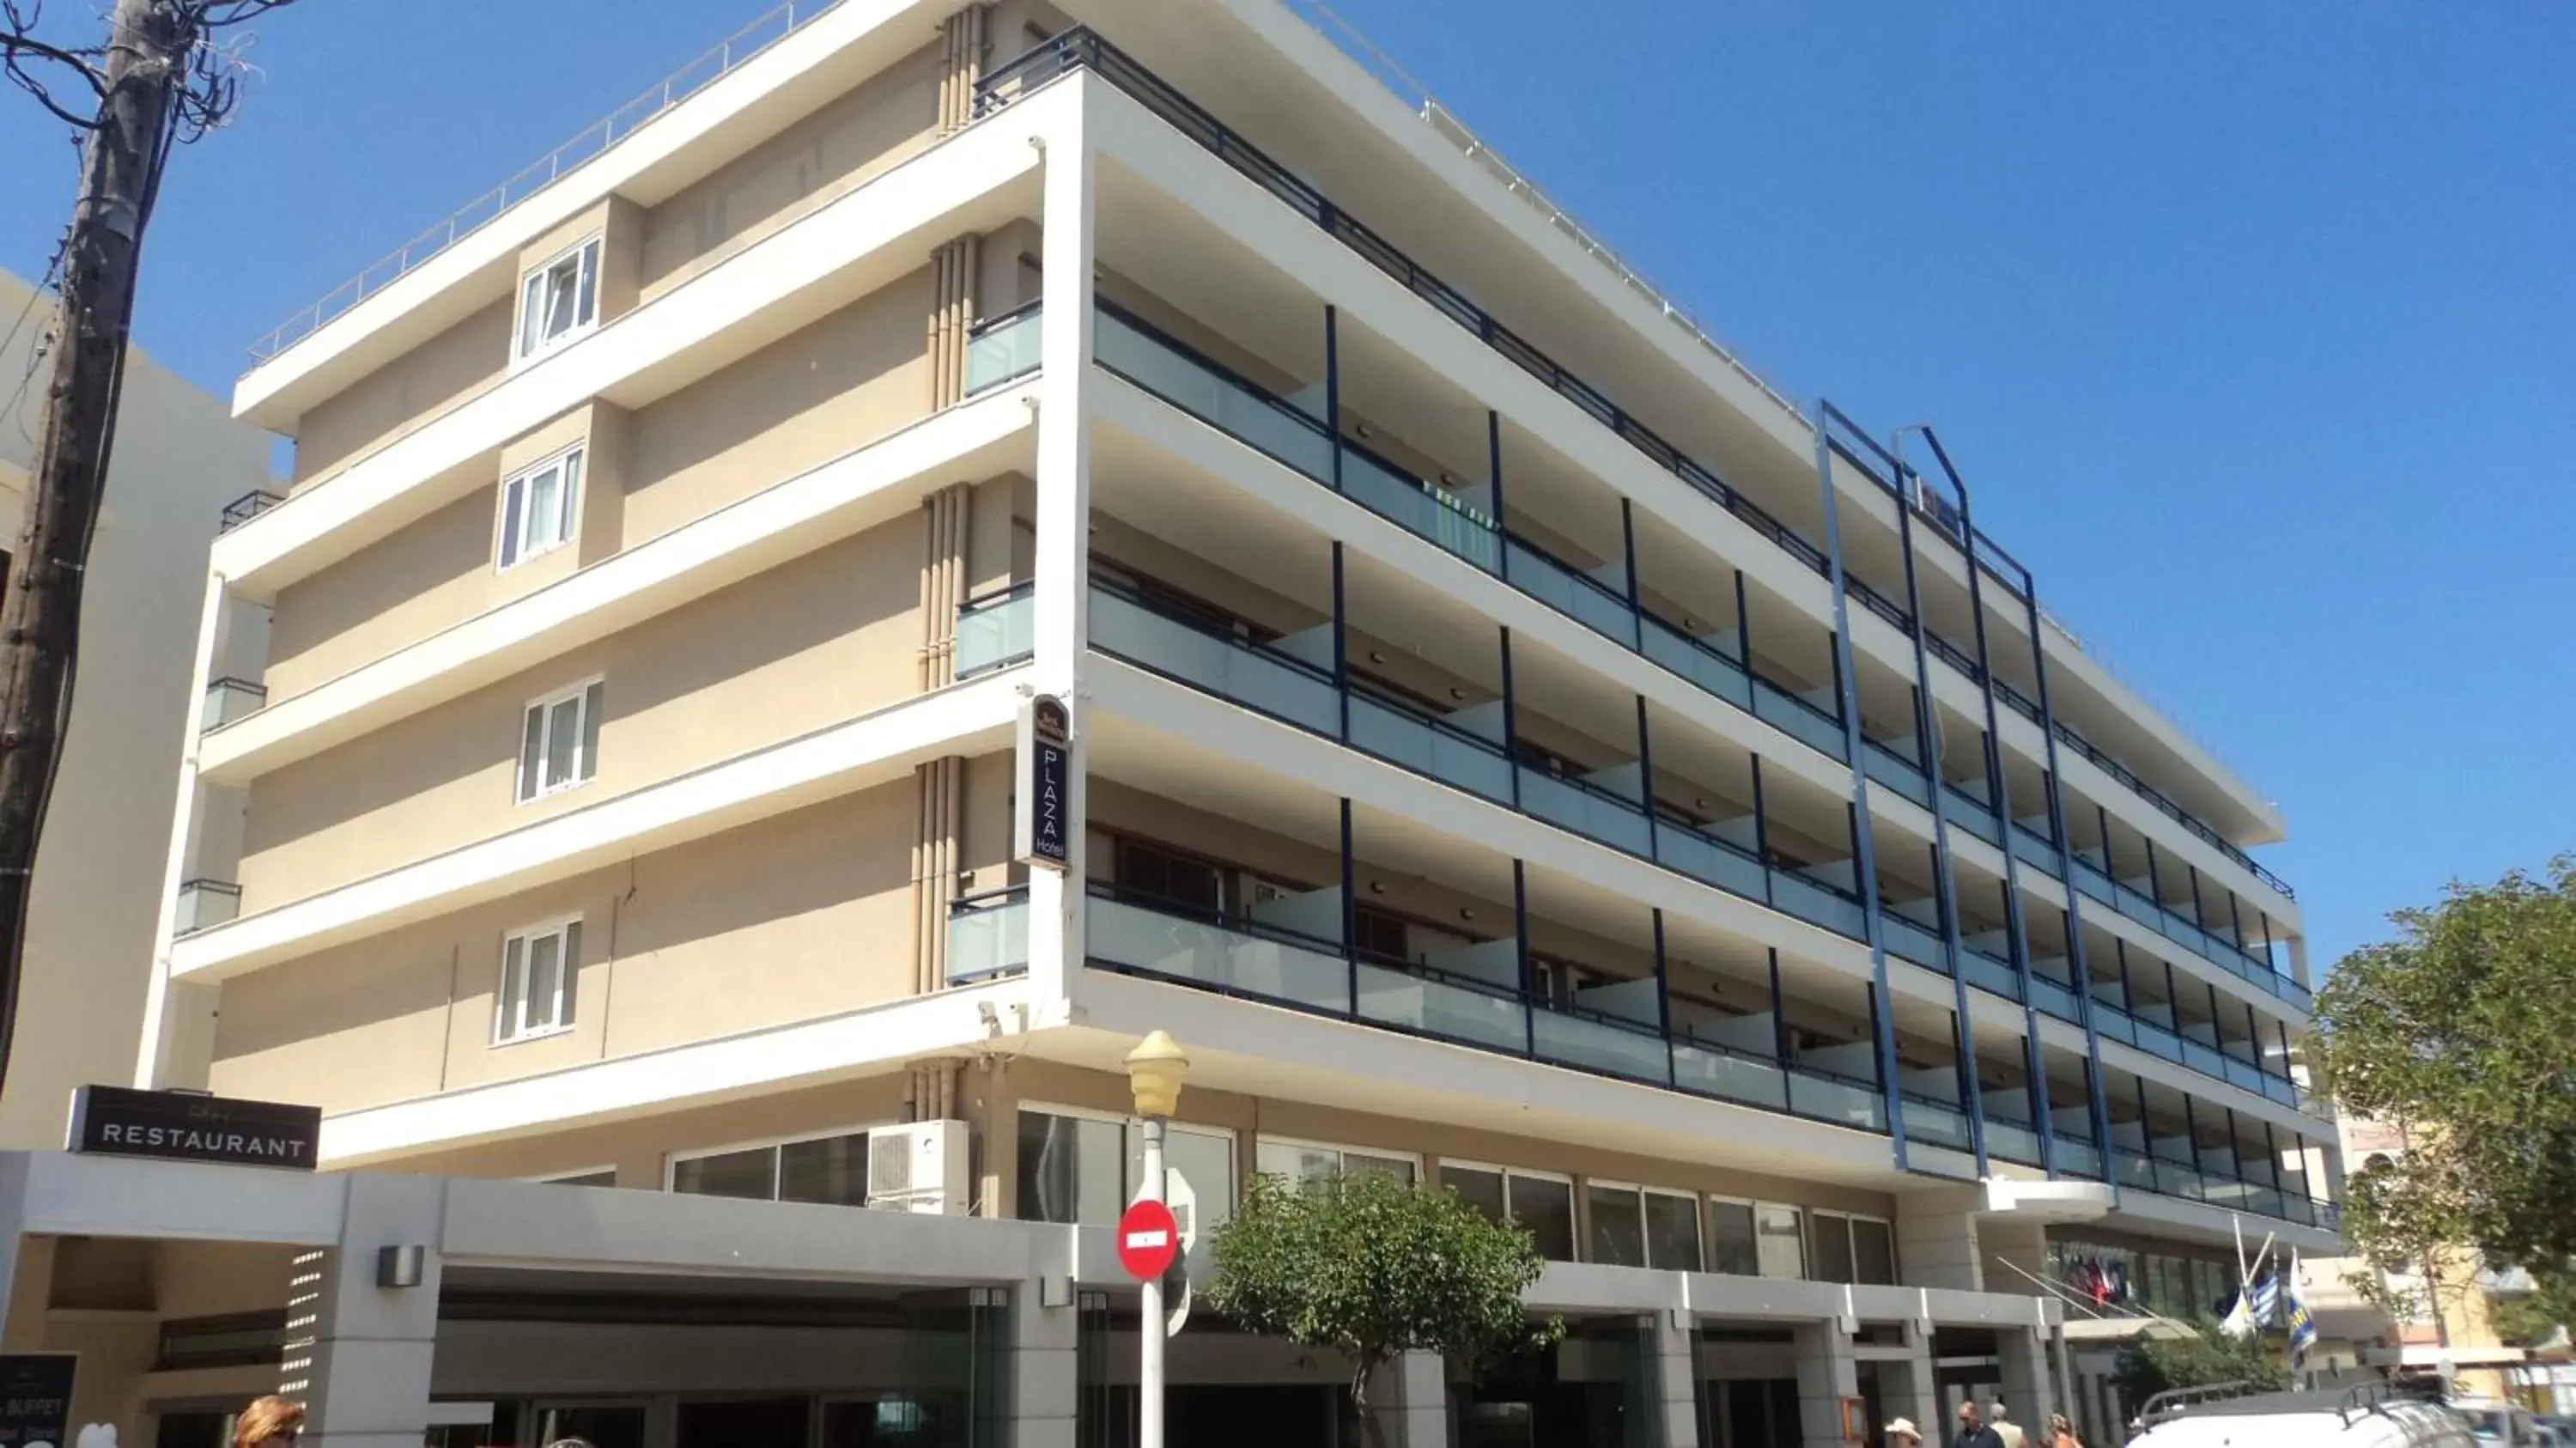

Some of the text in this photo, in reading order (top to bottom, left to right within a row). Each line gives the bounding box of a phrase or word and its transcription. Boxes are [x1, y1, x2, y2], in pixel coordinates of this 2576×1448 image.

[1042, 750, 1057, 838] PLAZA
[1036, 837, 1064, 856] Hotel
[101, 1123, 306, 1158] RESTAURANT
